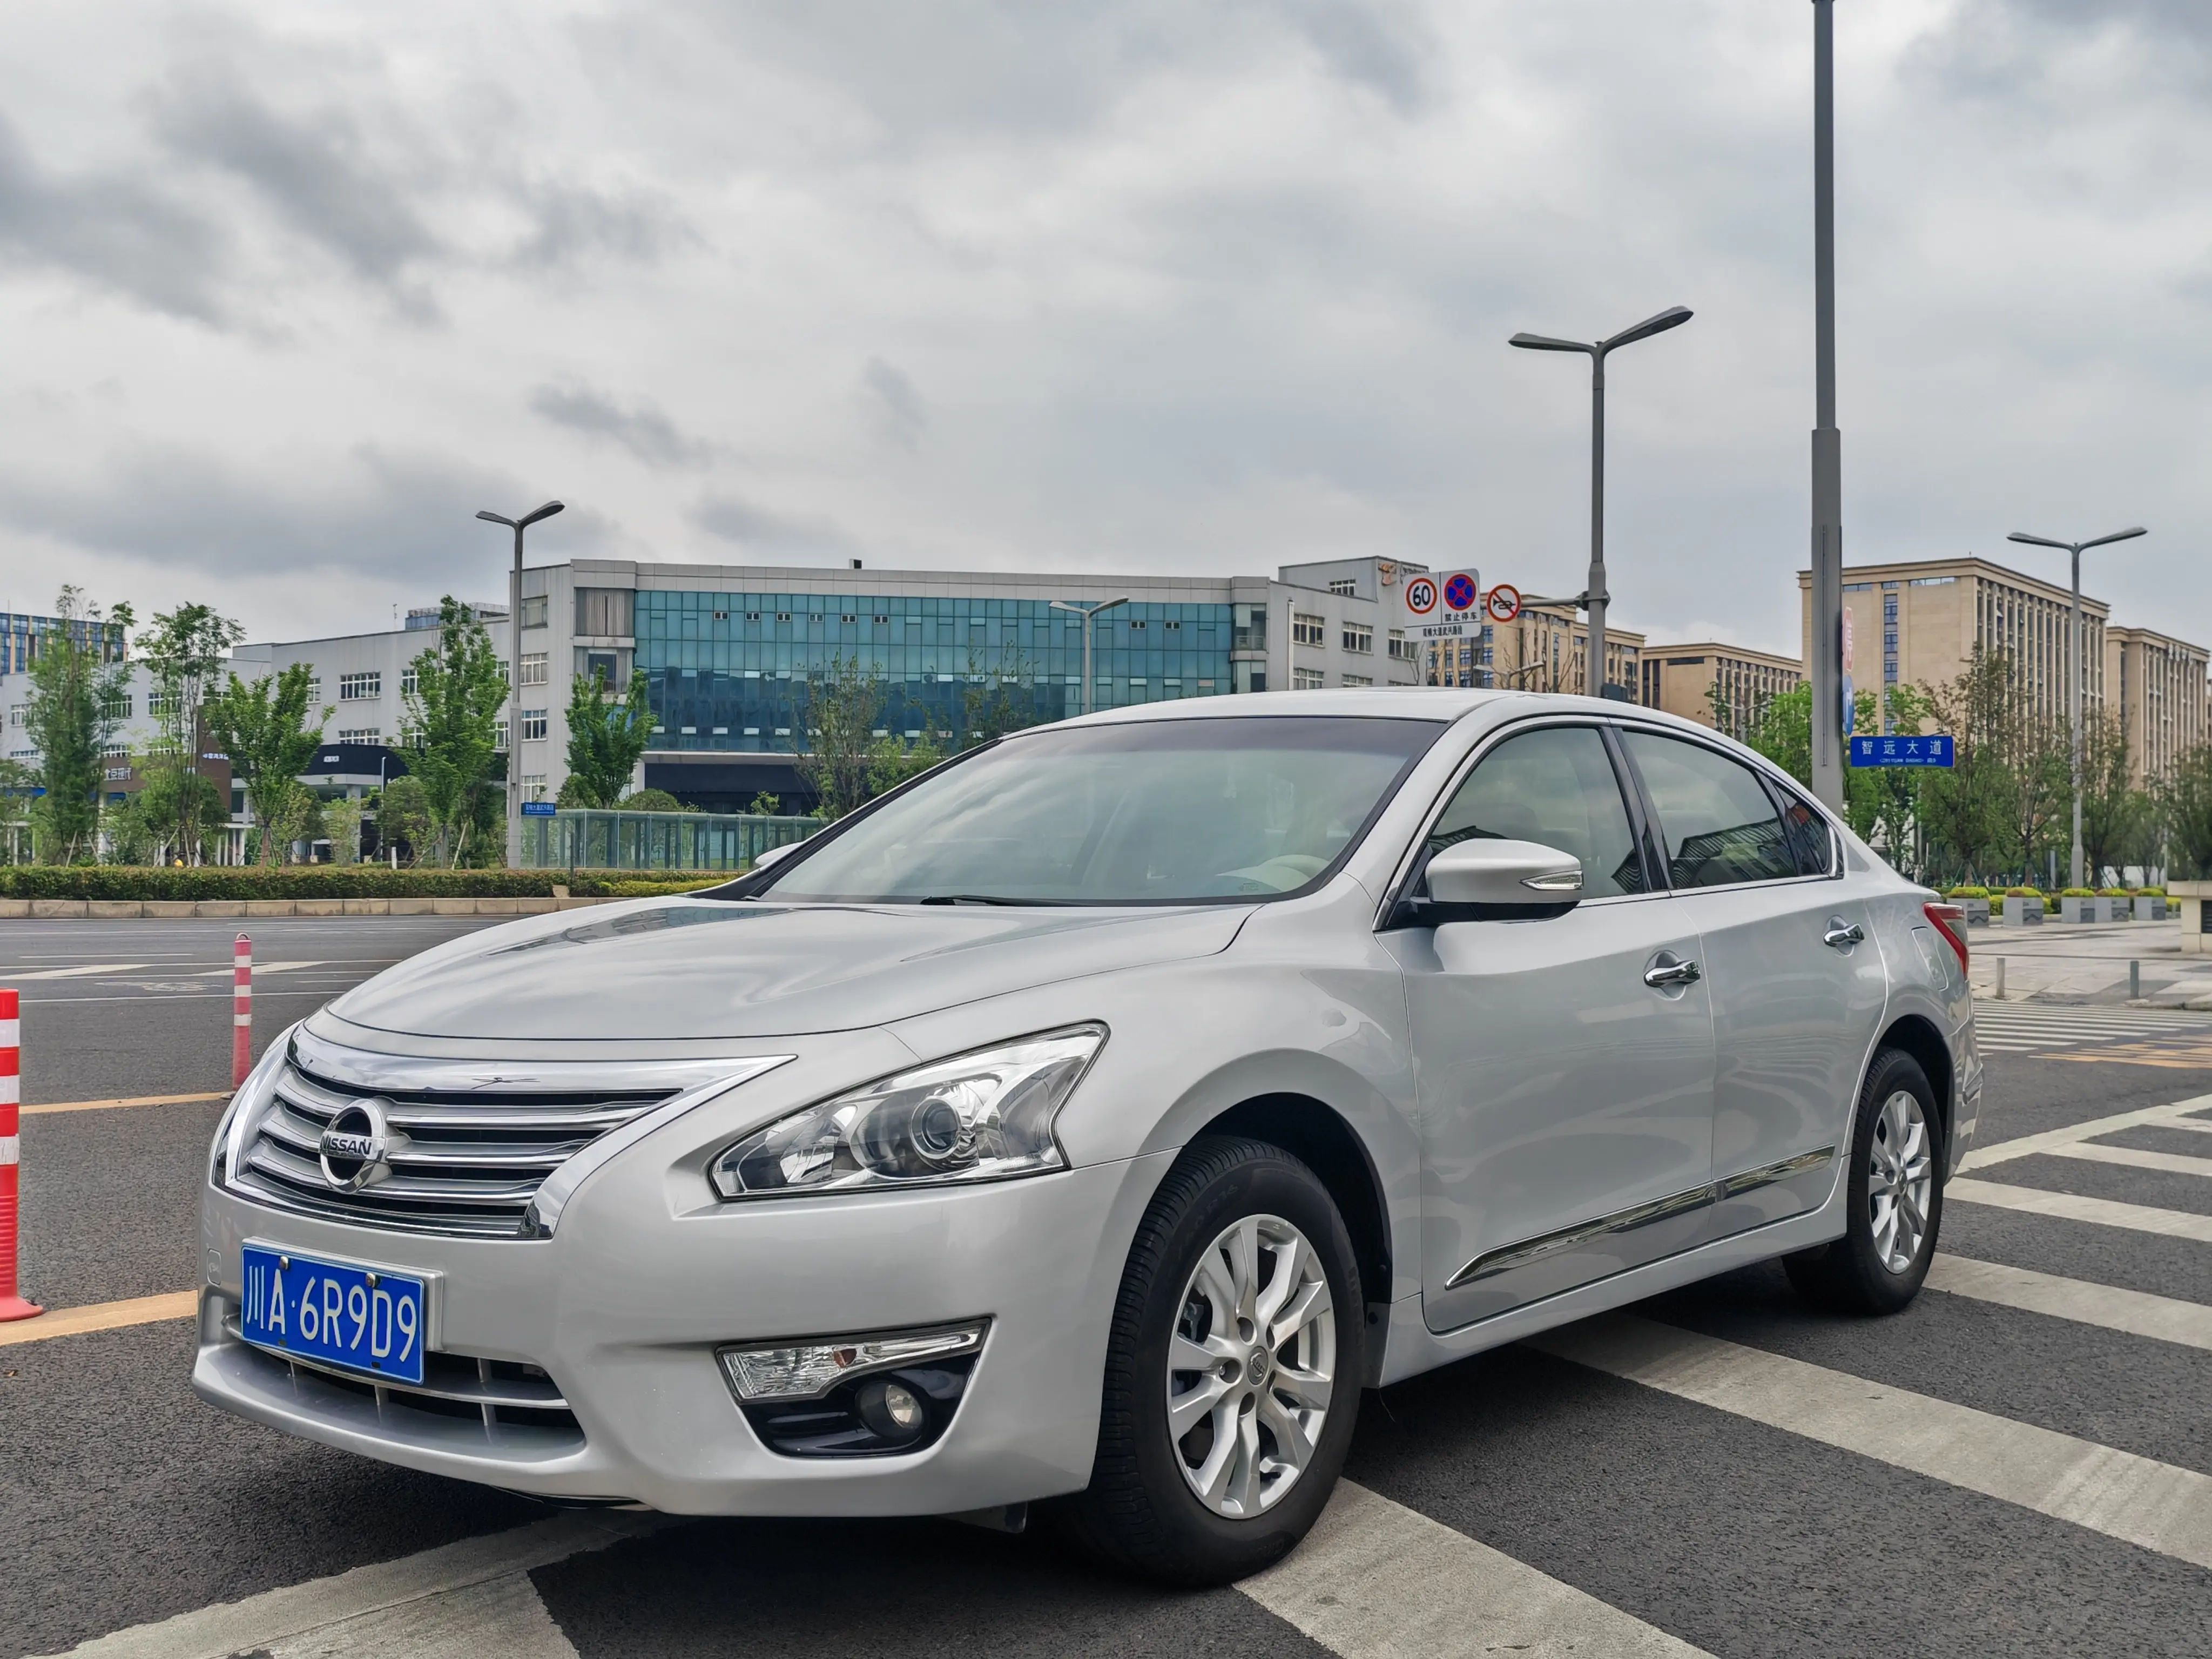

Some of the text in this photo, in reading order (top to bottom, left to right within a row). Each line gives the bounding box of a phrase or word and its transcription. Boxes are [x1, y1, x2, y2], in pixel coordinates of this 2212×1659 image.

[1413, 585, 1431, 606] 60
[1445, 612, 1478, 621] 禁止停车
[1862, 739, 1942, 755] 智远大道
[320, 1135, 372, 1155] NISSAN
